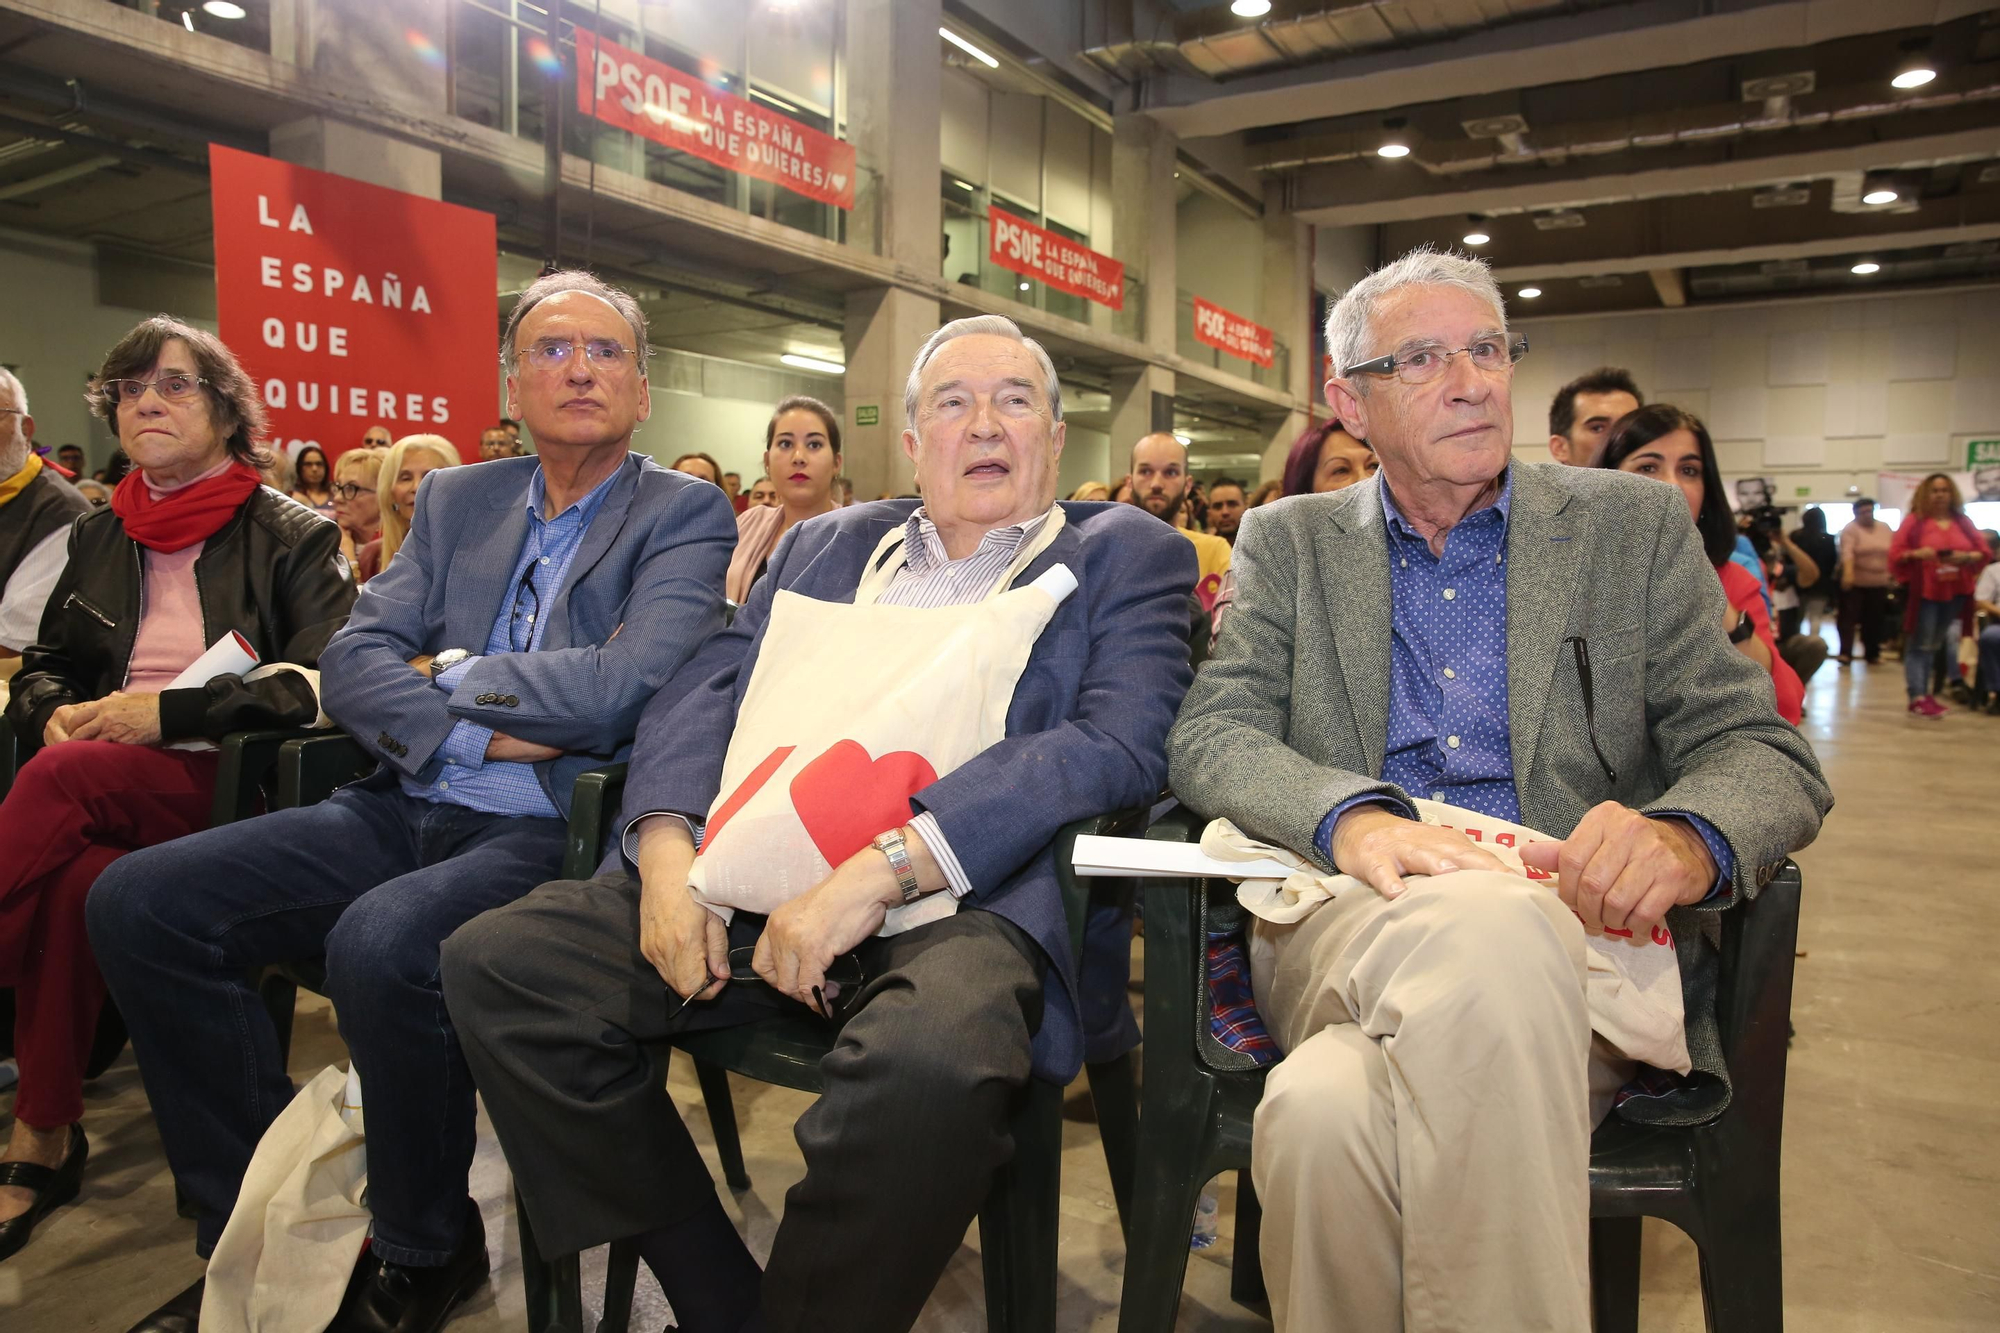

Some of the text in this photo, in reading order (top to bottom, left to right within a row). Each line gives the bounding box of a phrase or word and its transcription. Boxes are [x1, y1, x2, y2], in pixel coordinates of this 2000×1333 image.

[592, 49, 691, 136] PSOE
[701, 96, 805, 157] LA ESPAÑA
[701, 123, 740, 157] QUE
[258, 195, 313, 235] LA
[995, 218, 1043, 269] PSOE
[1045, 240, 1059, 260] LA
[261, 256, 431, 314] ESPAÑA
[1045, 258, 1066, 281] QUE
[263, 318, 348, 357] QUE
[264, 378, 449, 424] QUIERES
